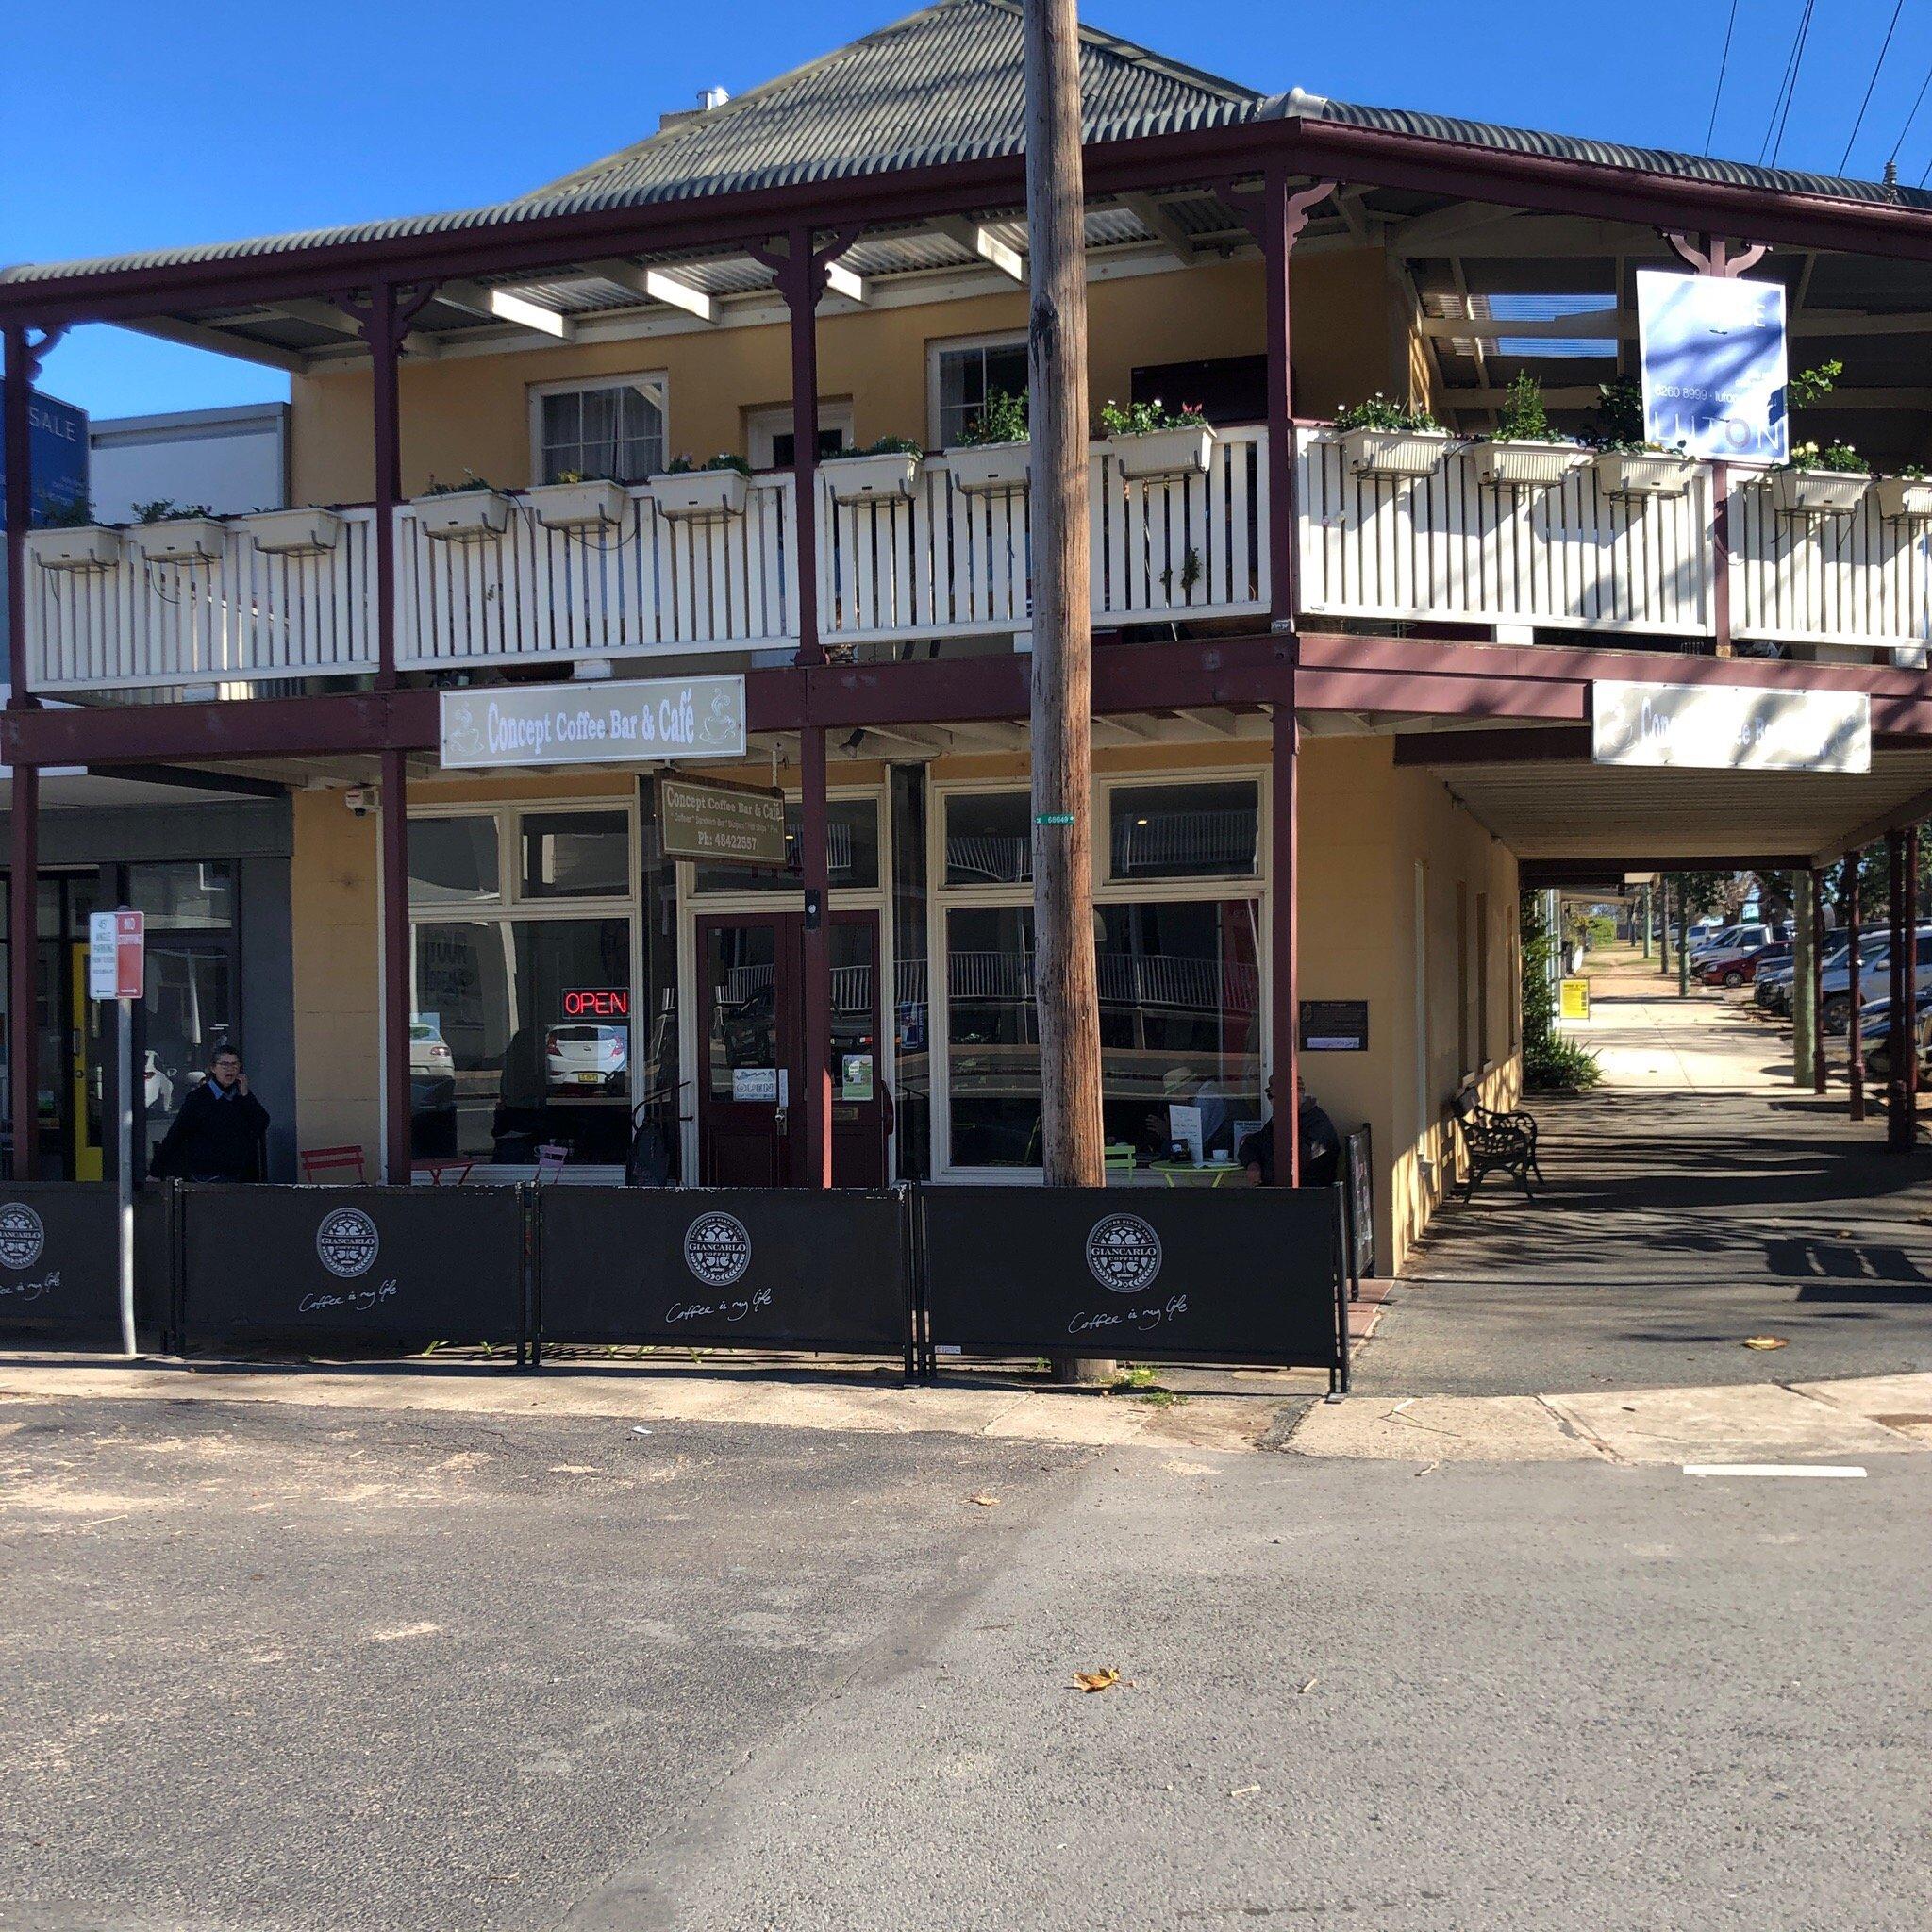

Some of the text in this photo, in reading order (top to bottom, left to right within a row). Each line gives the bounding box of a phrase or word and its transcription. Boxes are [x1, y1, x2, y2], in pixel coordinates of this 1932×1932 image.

[1682, 388, 1707, 401] 8999
[29, 407, 75, 441] SALE
[488, 688, 694, 755] Concept Coffee Bar & Café
[667, 786, 706, 811] Concept
[708, 798, 736, 812] Coffee
[738, 803, 753, 814] Bar
[755, 803, 761, 817] &
[697, 831, 757, 851] Ph: 48422557
[566, 992, 626, 1014] OPEN
[737, 1083, 774, 1093] OPEN
[689, 1243, 746, 1252] GIANCARLO
[1091, 1247, 1157, 1256] GIANCARLO
[299, 1293, 343, 1312] Coffee
[348, 1291, 357, 1300] is
[356, 1291, 375, 1310] my
[666, 1288, 773, 1323] Coffee is my life
[1068, 1294, 1188, 1333] Coffee is my life
